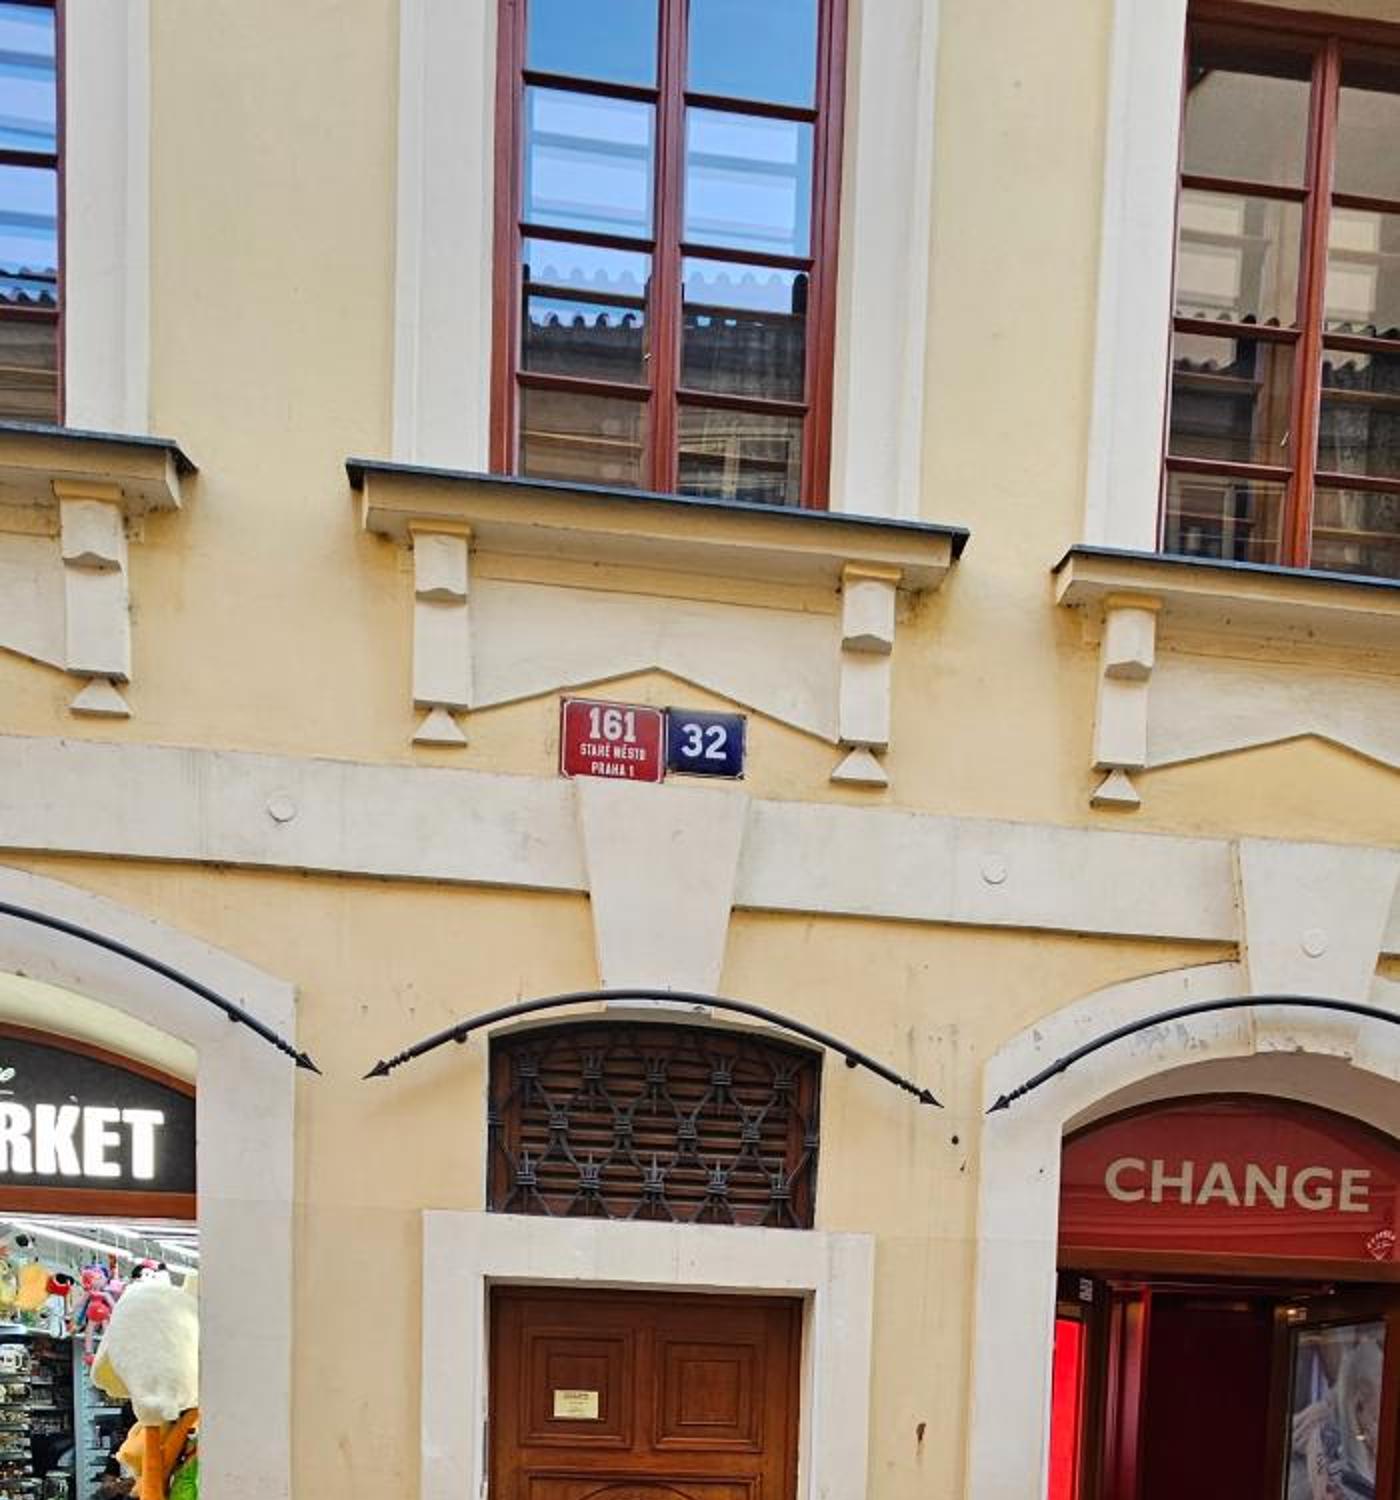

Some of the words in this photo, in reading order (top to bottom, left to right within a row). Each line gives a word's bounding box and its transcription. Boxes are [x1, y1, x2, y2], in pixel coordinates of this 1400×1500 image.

[589, 707, 637, 743] 161
[681, 723, 728, 760] 32
[591, 761, 626, 776] PRAHA
[629, 765, 635, 777] 1
[0, 1101, 165, 1180] RKET
[1104, 1157, 1371, 1212] CHANGE
